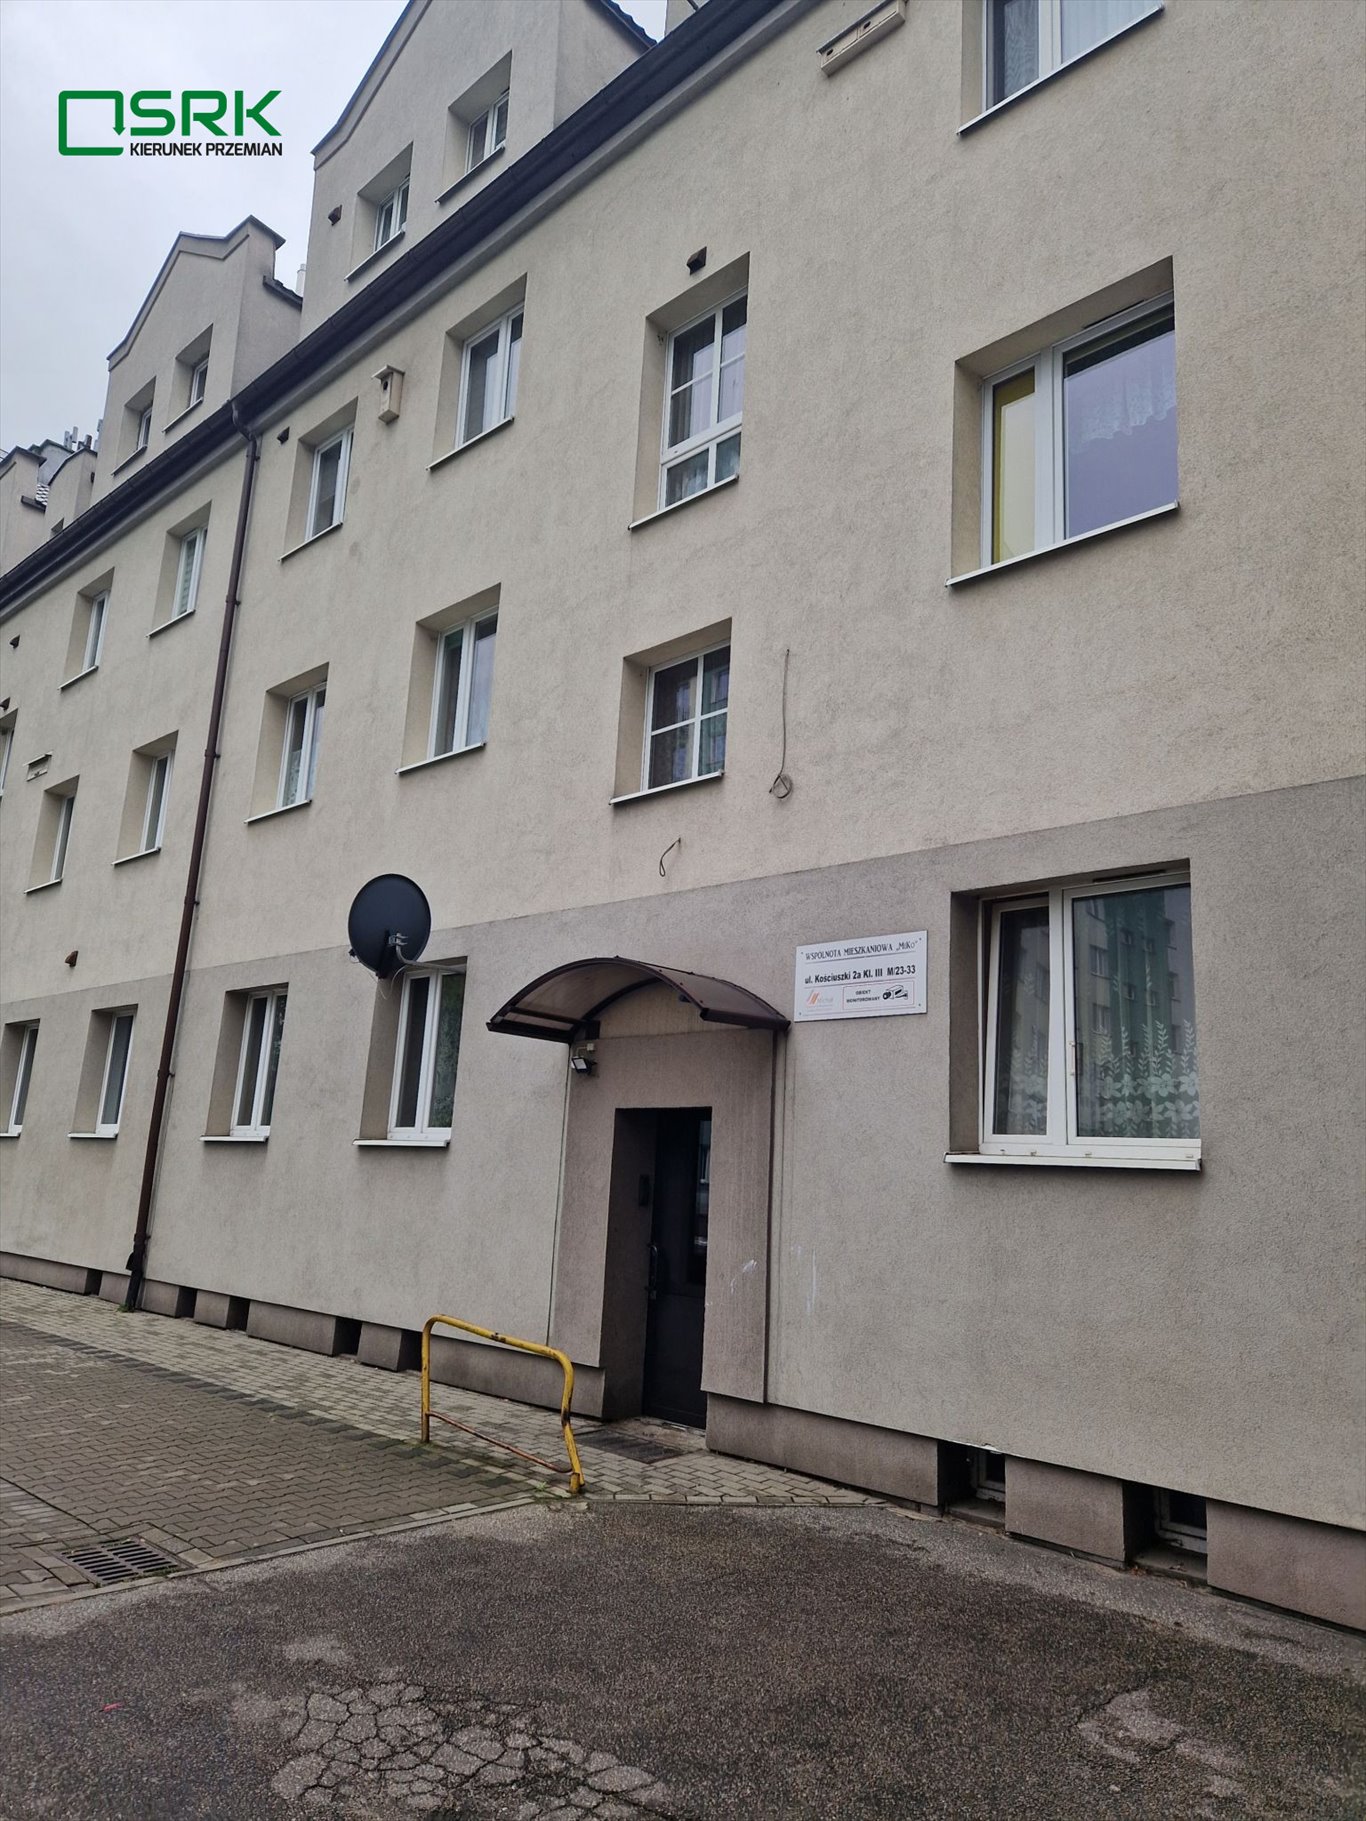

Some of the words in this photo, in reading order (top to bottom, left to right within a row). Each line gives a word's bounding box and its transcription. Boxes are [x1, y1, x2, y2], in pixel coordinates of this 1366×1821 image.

[844, 943, 893, 956] MIESZKANIOWA
[805, 974, 813, 984] ul.
[815, 971, 851, 983] Kościuszki
[853, 970, 862, 980] 2a
[863, 969, 873, 979] Kl.
[875, 967, 883, 977] III
